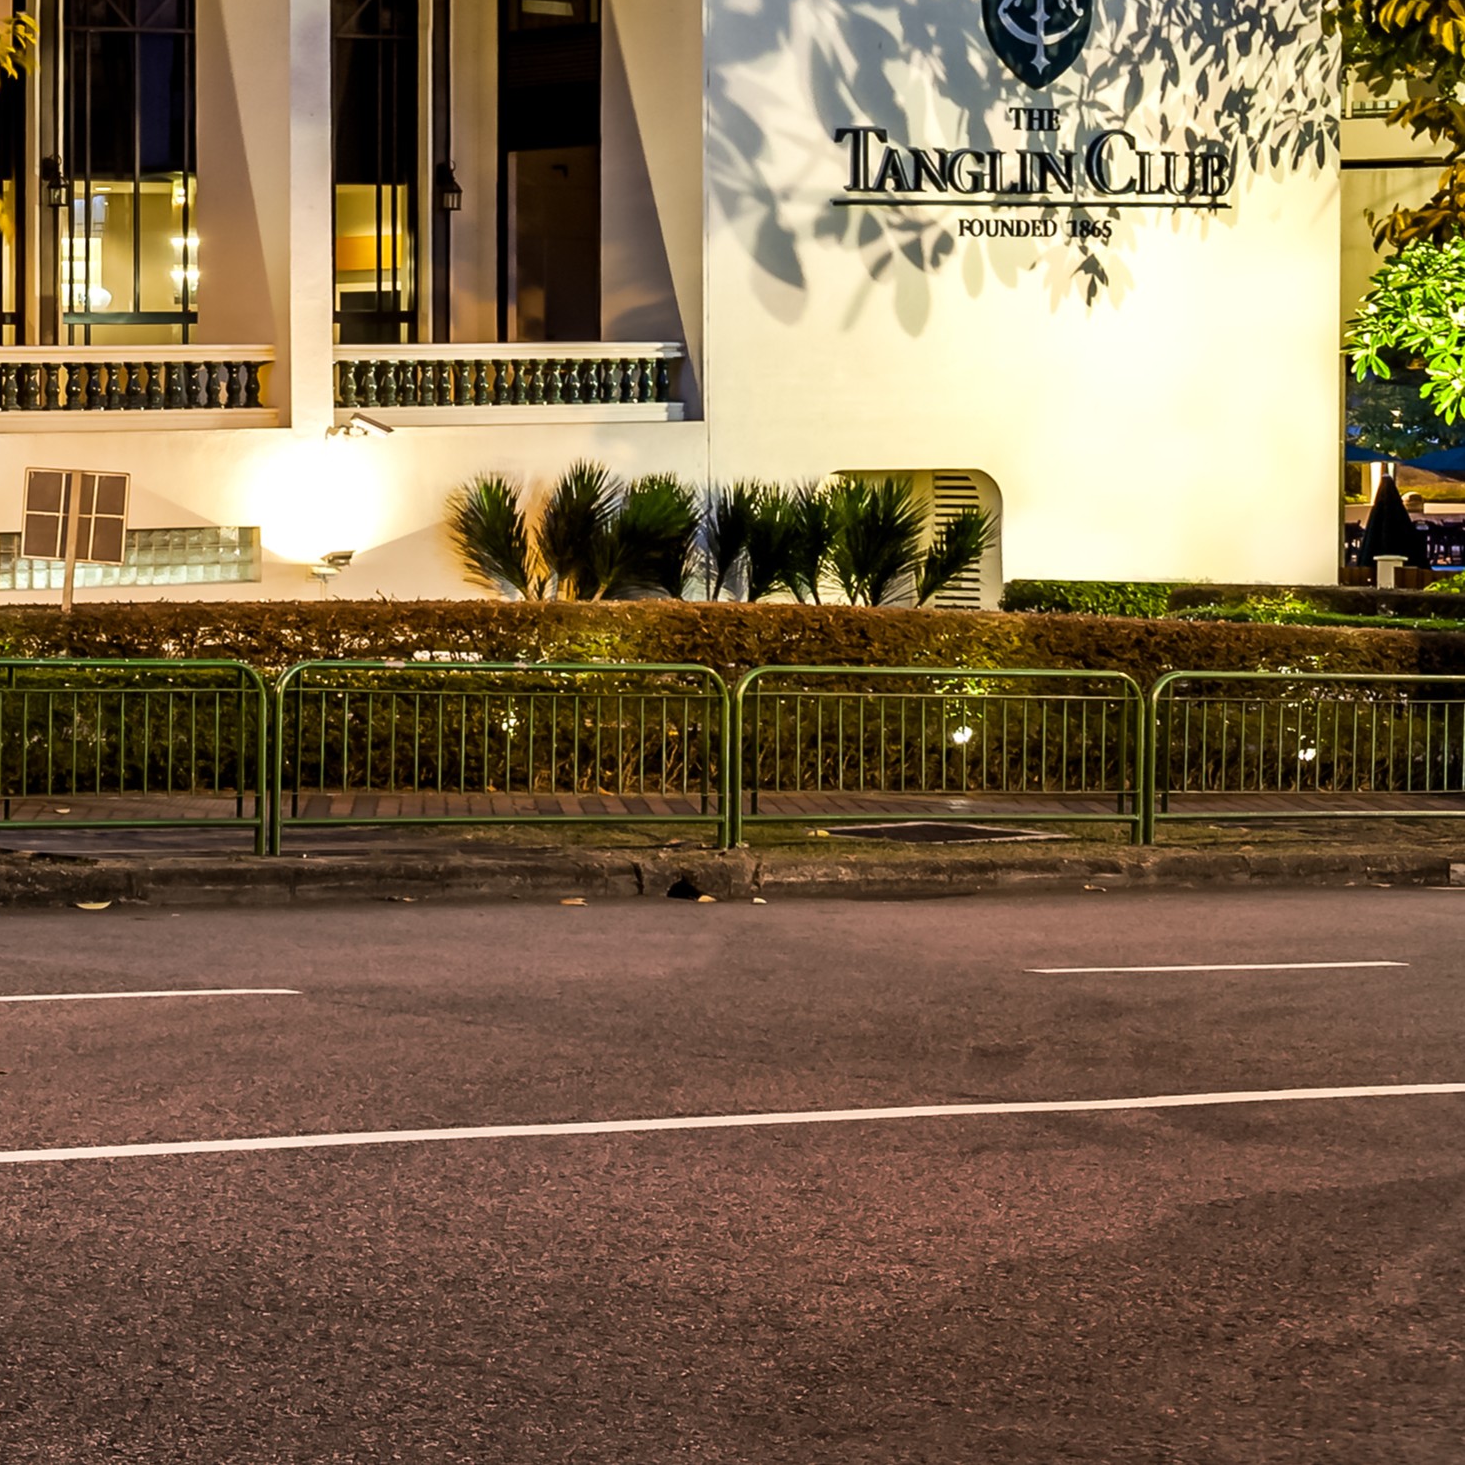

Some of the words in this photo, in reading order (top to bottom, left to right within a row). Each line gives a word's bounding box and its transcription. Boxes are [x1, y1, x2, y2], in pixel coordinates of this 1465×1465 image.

[1009, 108, 1061, 131] THE
[834, 128, 1075, 195] TANGLIN
[1084, 131, 1232, 196] CLUB
[958, 219, 1057, 238] FOUNDED
[1069, 220, 1113, 238] 1865
